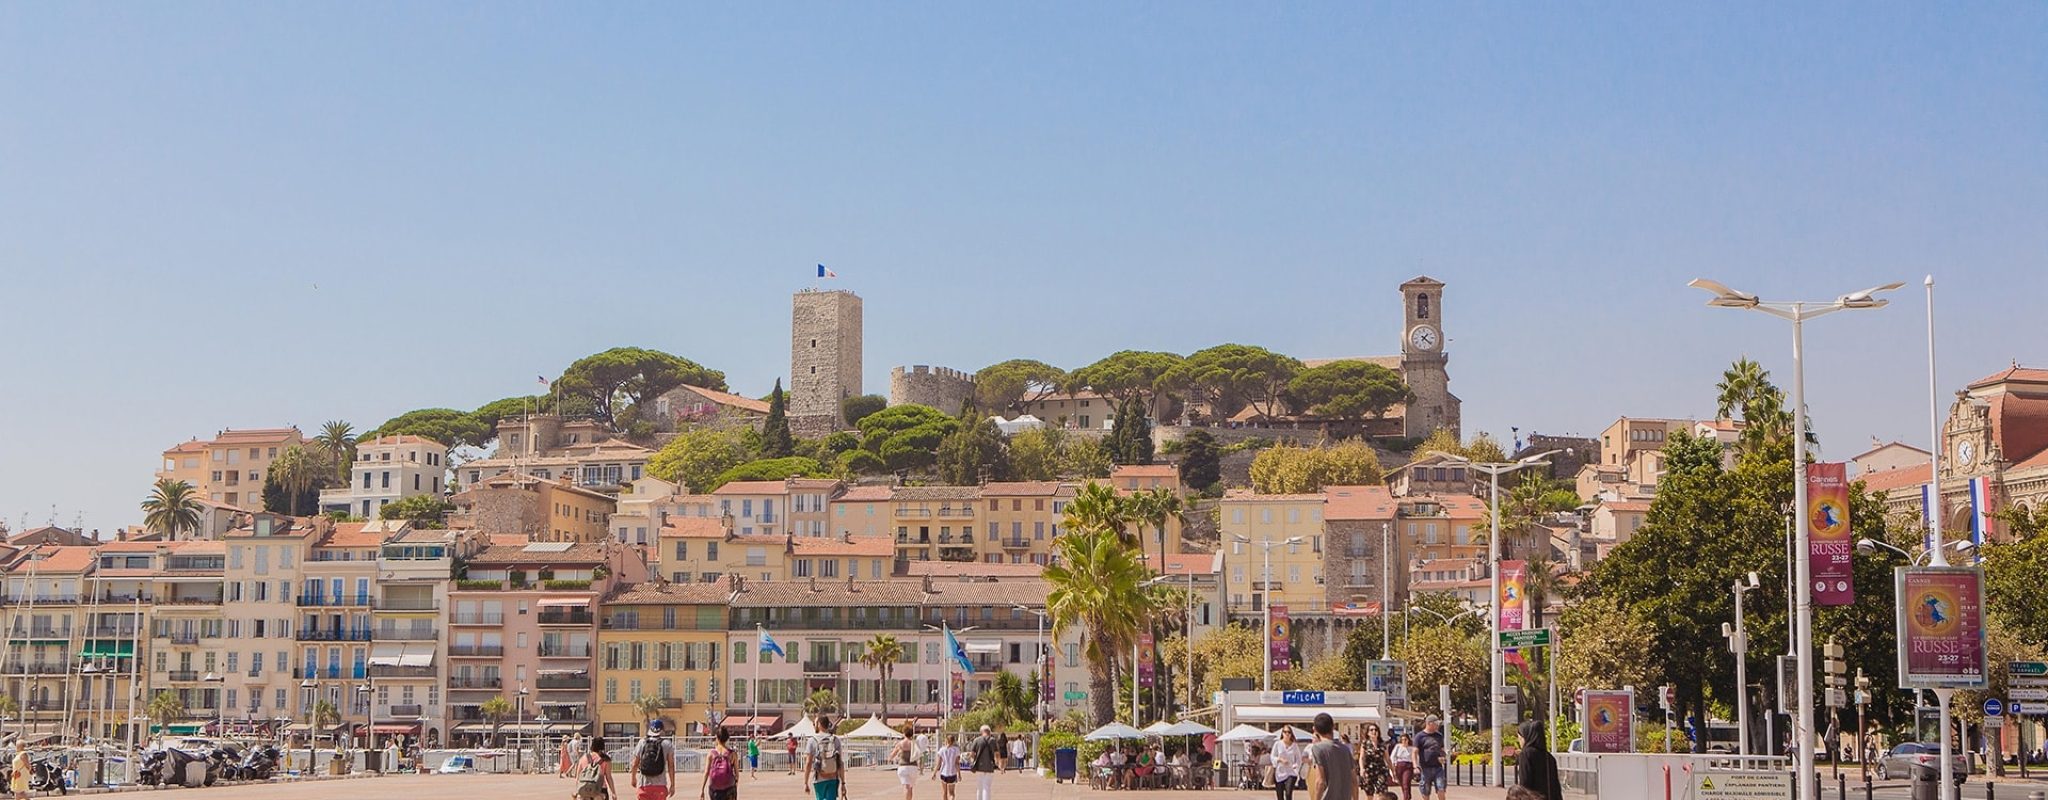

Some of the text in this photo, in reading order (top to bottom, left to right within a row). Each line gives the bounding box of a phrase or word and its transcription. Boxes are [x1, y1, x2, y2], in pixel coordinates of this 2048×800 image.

[1811, 543, 1849, 555] RUSSE
[1913, 640, 1959, 653] RUSSE
[1286, 692, 1320, 702] PHILCAT
